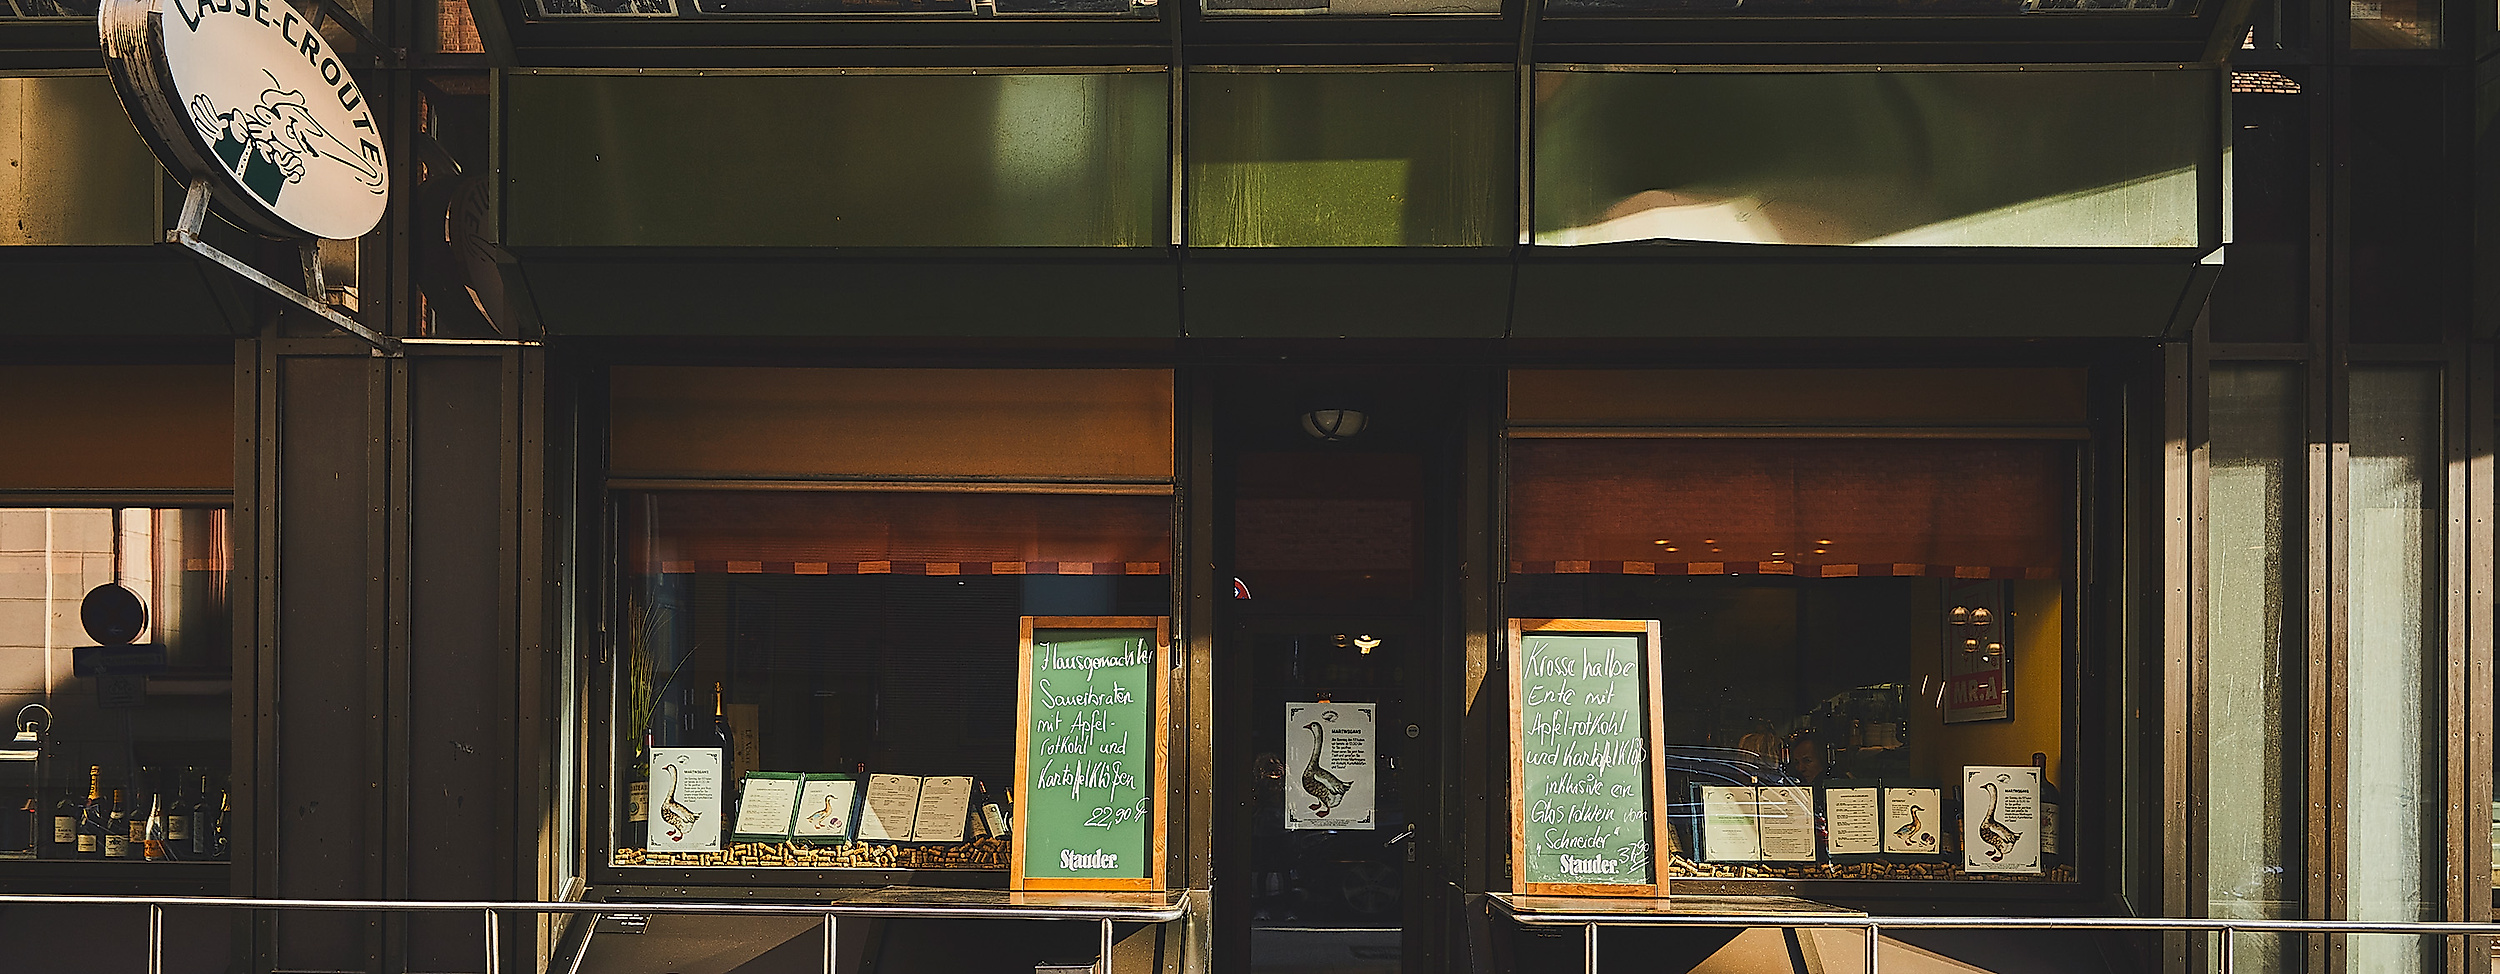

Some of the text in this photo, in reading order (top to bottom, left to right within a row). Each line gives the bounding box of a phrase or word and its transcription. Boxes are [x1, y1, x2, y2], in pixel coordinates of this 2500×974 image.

[1524, 641, 1636, 680] Krosse halbe
[1039, 678, 1134, 709] Sauerbraten
[1527, 679, 1616, 706] Ente mit
[1037, 710, 1063, 733] mit
[1099, 730, 1128, 755] und
[1526, 742, 1561, 767] und
[1610, 780, 1635, 799] ein
[1531, 798, 1565, 825] Glas
